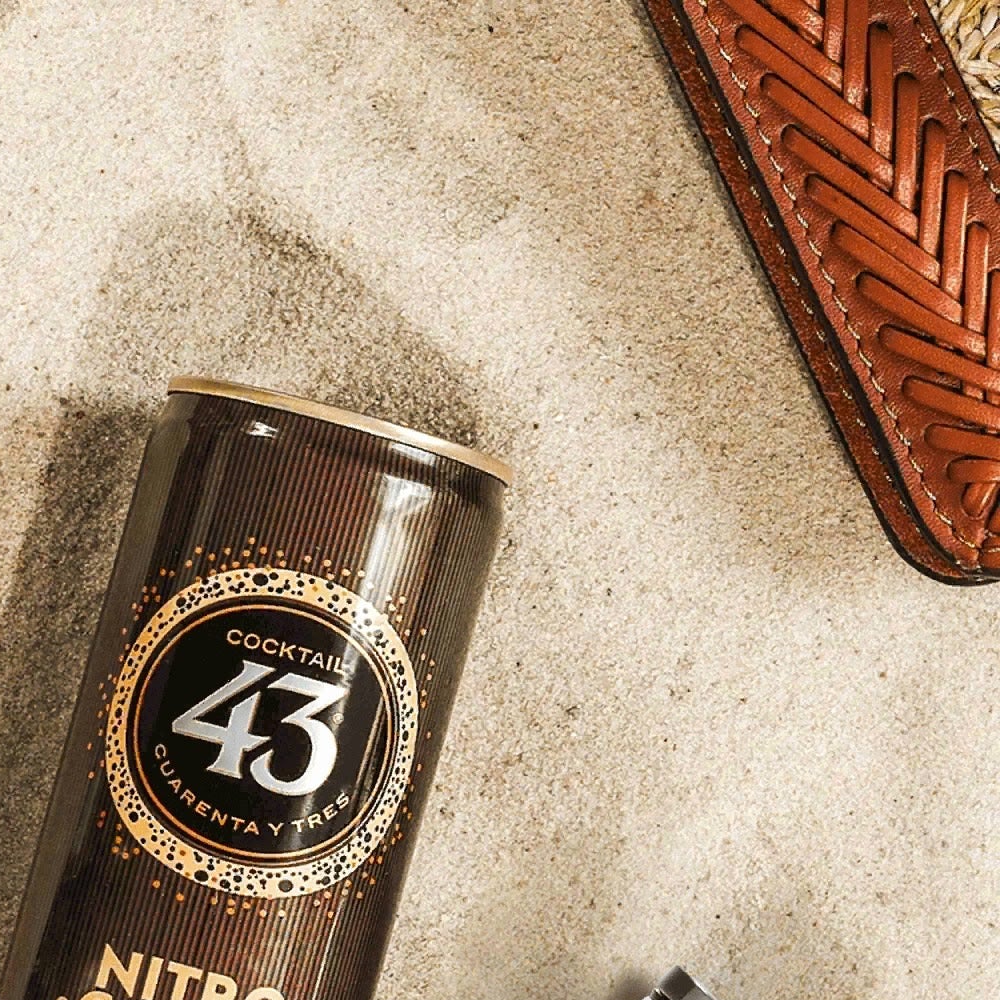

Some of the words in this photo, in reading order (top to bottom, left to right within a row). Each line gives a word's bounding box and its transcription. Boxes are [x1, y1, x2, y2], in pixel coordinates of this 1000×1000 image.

[227, 629, 348, 677] COCKTAIL
[172, 660, 349, 796] 43
[155, 743, 260, 836] CUARENTA
[268, 822, 285, 837] Y
[292, 792, 350, 834] TRES
